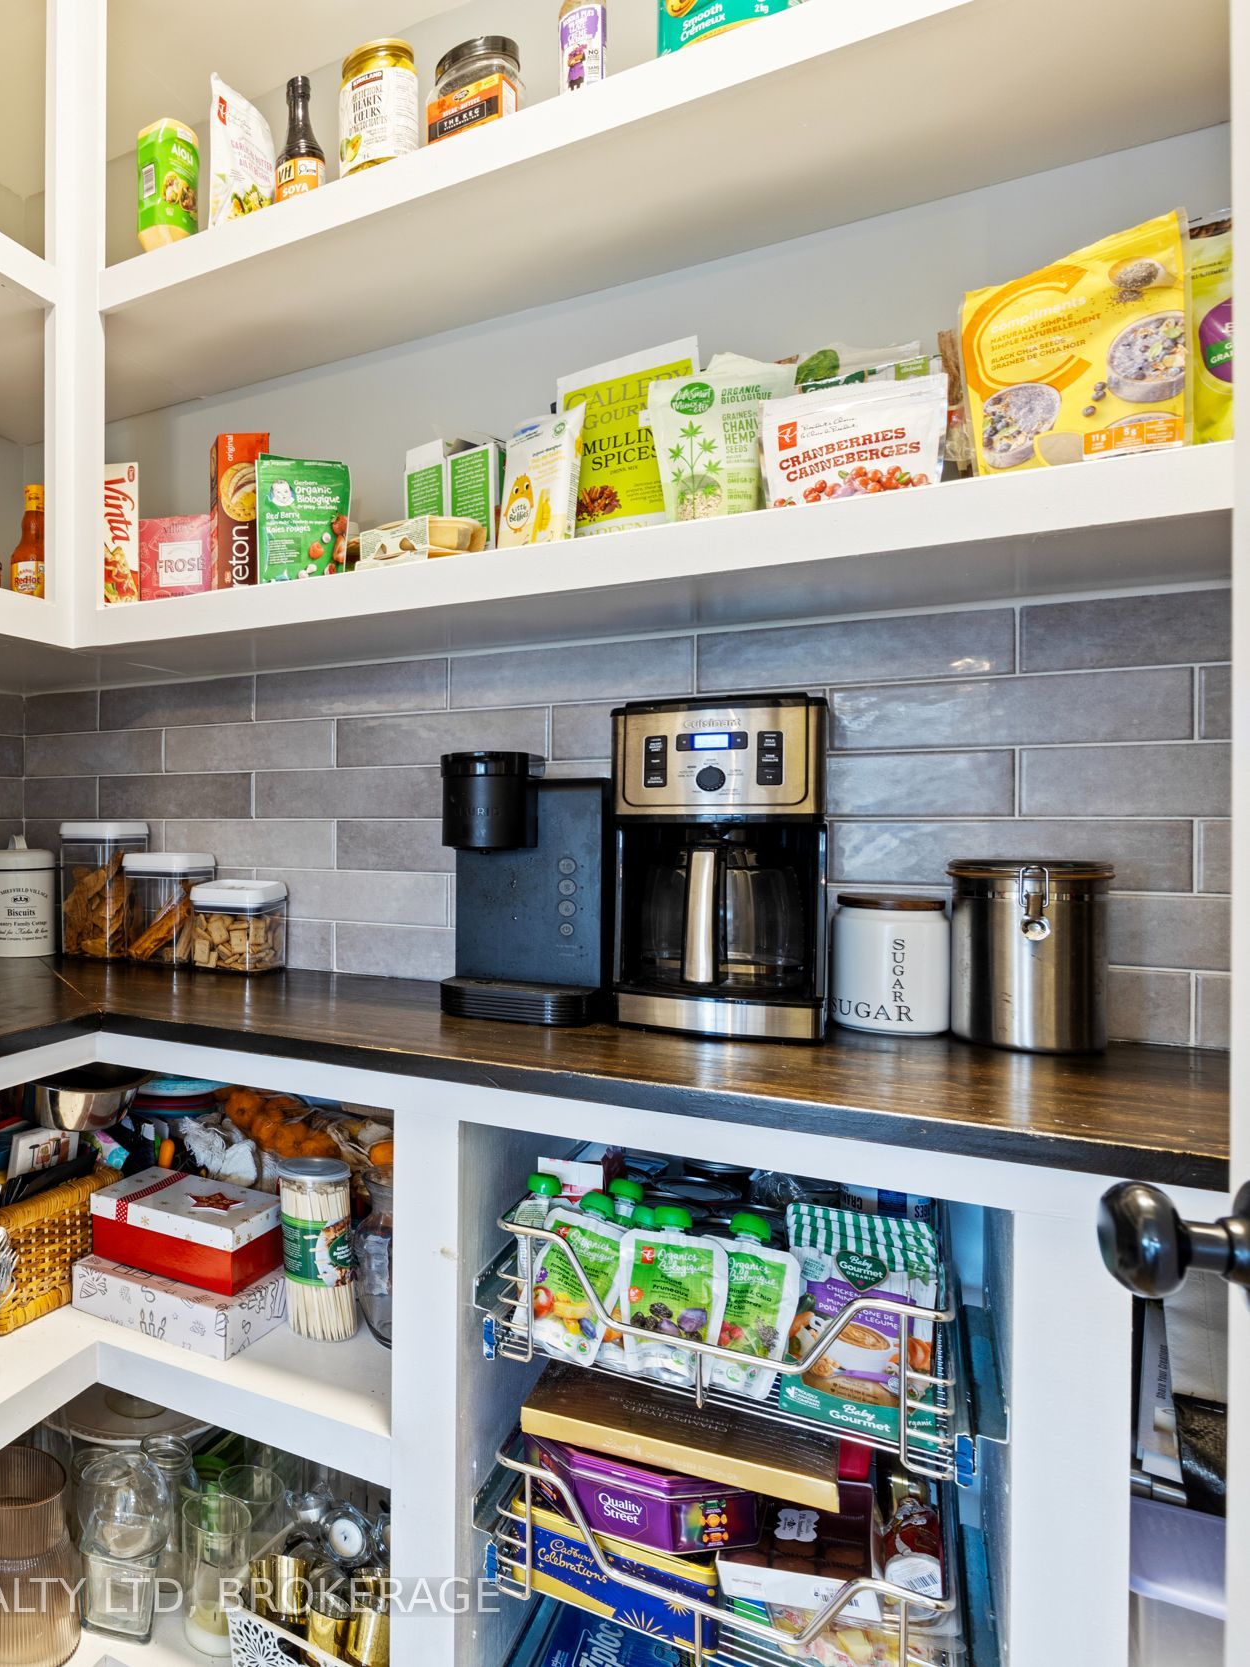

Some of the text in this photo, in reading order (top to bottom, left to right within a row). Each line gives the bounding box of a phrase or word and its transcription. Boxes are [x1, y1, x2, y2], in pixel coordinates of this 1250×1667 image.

[682, 2, 724, 31] Smooth
[680, 13, 726, 42] Crémeux
[353, 94, 383, 113] HEARTS
[444, 107, 481, 127] THE KEG
[172, 143, 194, 165] AIOLI
[277, 165, 292, 183] VH
[282, 181, 309, 198] SOYA
[990, 296, 1086, 334] compliments
[990, 313, 1074, 344] NATURALLY SIMPLE
[990, 312, 1102, 352] SIMPLE NATURELLEMENT
[990, 337, 1066, 365] BLACK CHIA SEEDS
[990, 339, 1086, 371] GRAINES DE CHIA NOIR
[721, 385, 761, 397] ORGANIC
[721, 392, 772, 405] BIOLOGIQUE
[584, 401, 649, 430] GOURM
[722, 410, 752, 421] GRAINES
[722, 418, 759, 433] CHANV
[583, 428, 654, 457] MULLIN
[724, 431, 756, 445] HEMP
[226, 435, 236, 462] original
[726, 445, 748, 454] SEEDS
[779, 427, 907, 471] CRANBERRIES
[591, 446, 658, 471] SPICES
[786, 441, 922, 483] CANNEBERGES
[295, 486, 333, 497] Organic
[296, 495, 341, 506] Biologique
[104, 477, 135, 545] Vinta
[265, 511, 300, 521] Red Berry
[285, 525, 311, 534] rouges
[228, 528, 250, 588] reton
[682, 716, 742, 730] Cuisinart
[7, 908, 36, 917] Biscuits
[891, 938, 905, 1002] SUGAR
[829, 997, 914, 1022] SUGAR
[569, 1228, 610, 1250] Organics
[657, 1248, 698, 1263] Organics
[849, 1254, 873, 1269] Baby
[658, 1260, 710, 1278] Biologique
[729, 1269, 777, 1287] Biologique
[839, 1260, 884, 1280] Gourmet
[846, 1271, 876, 1282] ORGANIC
[652, 1284, 689, 1298] Pruneaux
[826, 1284, 862, 1298] CHICKEN
[884, 1313, 895, 1322] DE
[1157, 1369, 1167, 1382] Your
[1156, 1383, 1166, 1400] Share
[829, 1410, 891, 1433] Gourmet
[843, 1404, 876, 1422] Baby
[908, 1419, 932, 1428] rganic
[598, 1491, 643, 1517] Quality
[603, 1503, 641, 1526] Street
[549, 1538, 596, 1564] Cadbury
[537, 1546, 608, 1585] Celebrations
